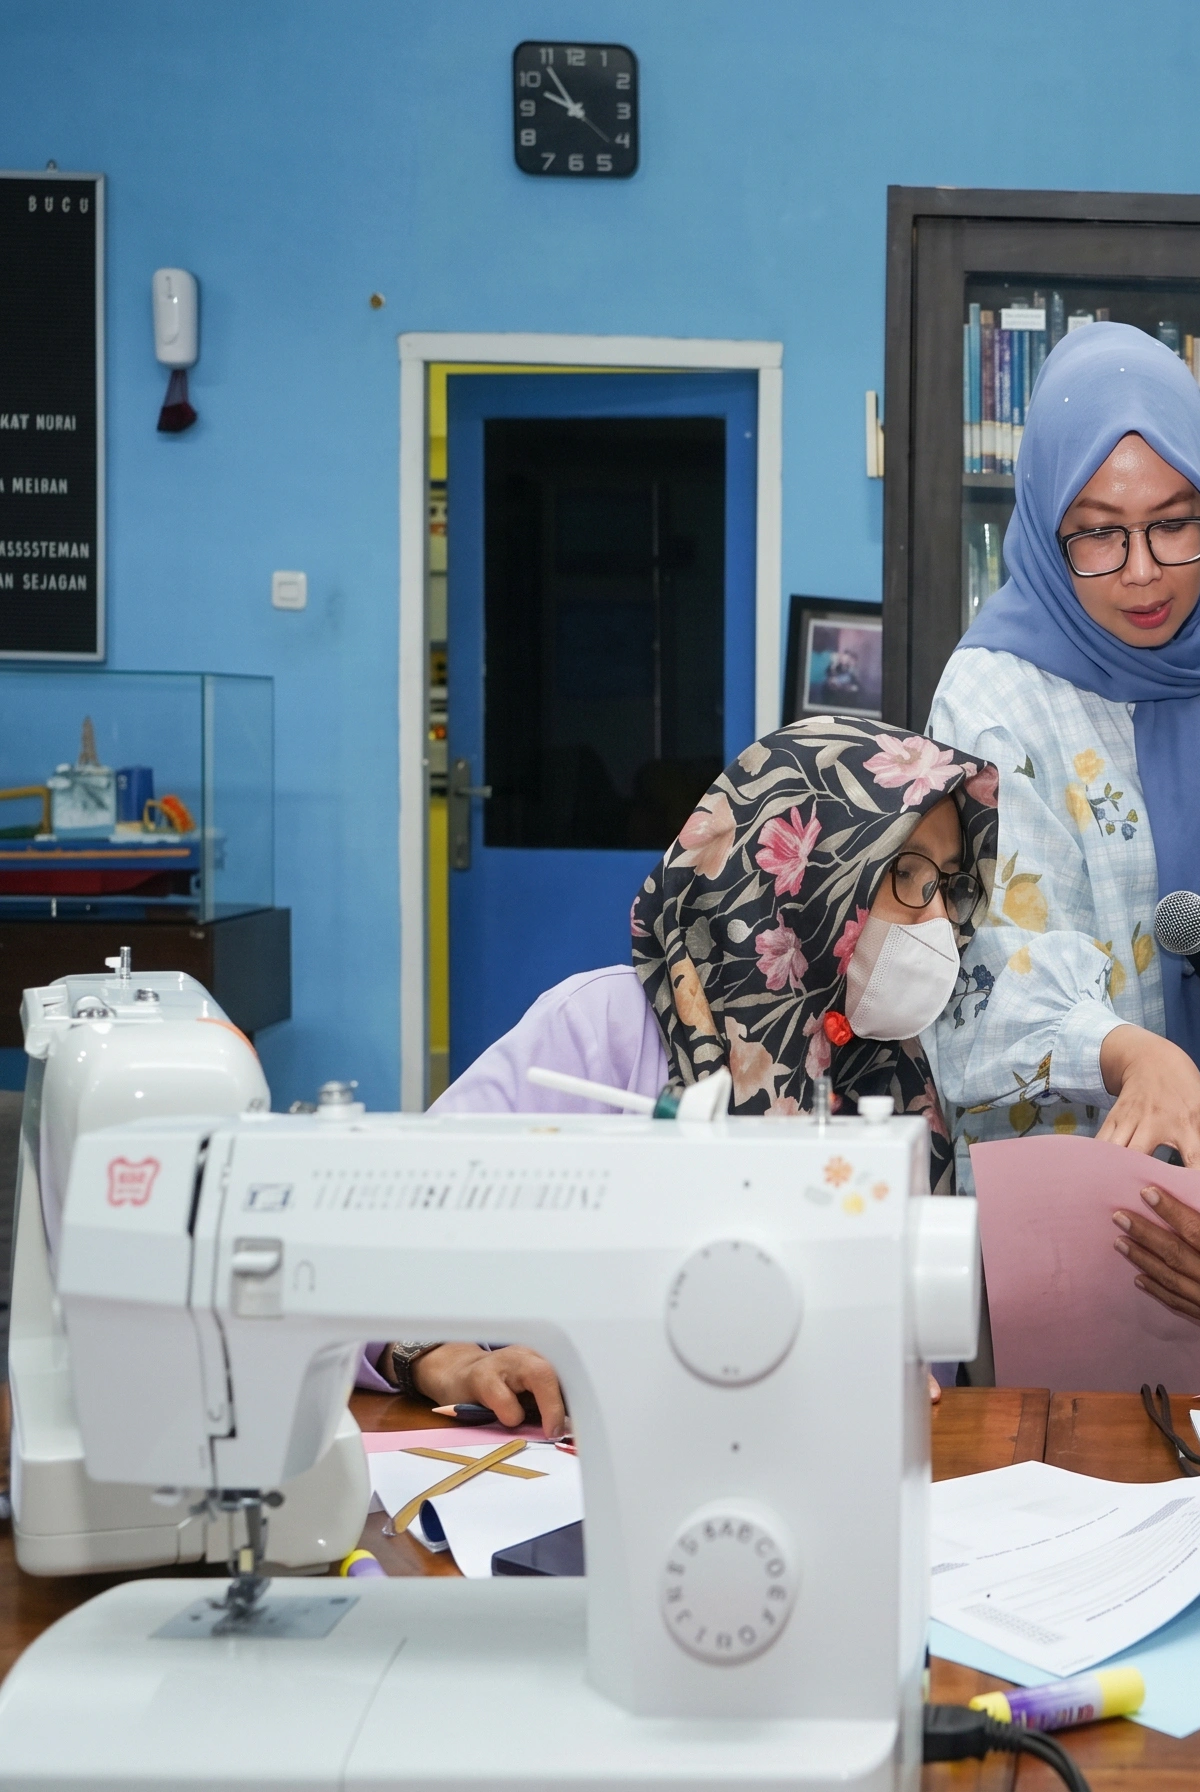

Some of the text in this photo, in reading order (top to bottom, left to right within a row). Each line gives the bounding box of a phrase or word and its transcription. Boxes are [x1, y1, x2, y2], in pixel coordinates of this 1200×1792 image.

[539, 47, 554, 65] 11
[565, 48, 587, 66] 12
[600, 49, 608, 67] 1
[519, 70, 541, 88] 10
[615, 72, 631, 90] 2
[519, 99, 536, 117] 9
[616, 102, 631, 120] 3
[520, 128, 537, 147] 8
[614, 131, 631, 149] 4
[540, 152, 556, 171] 7
[567, 153, 585, 172] 6
[596, 153, 613, 172] 5
